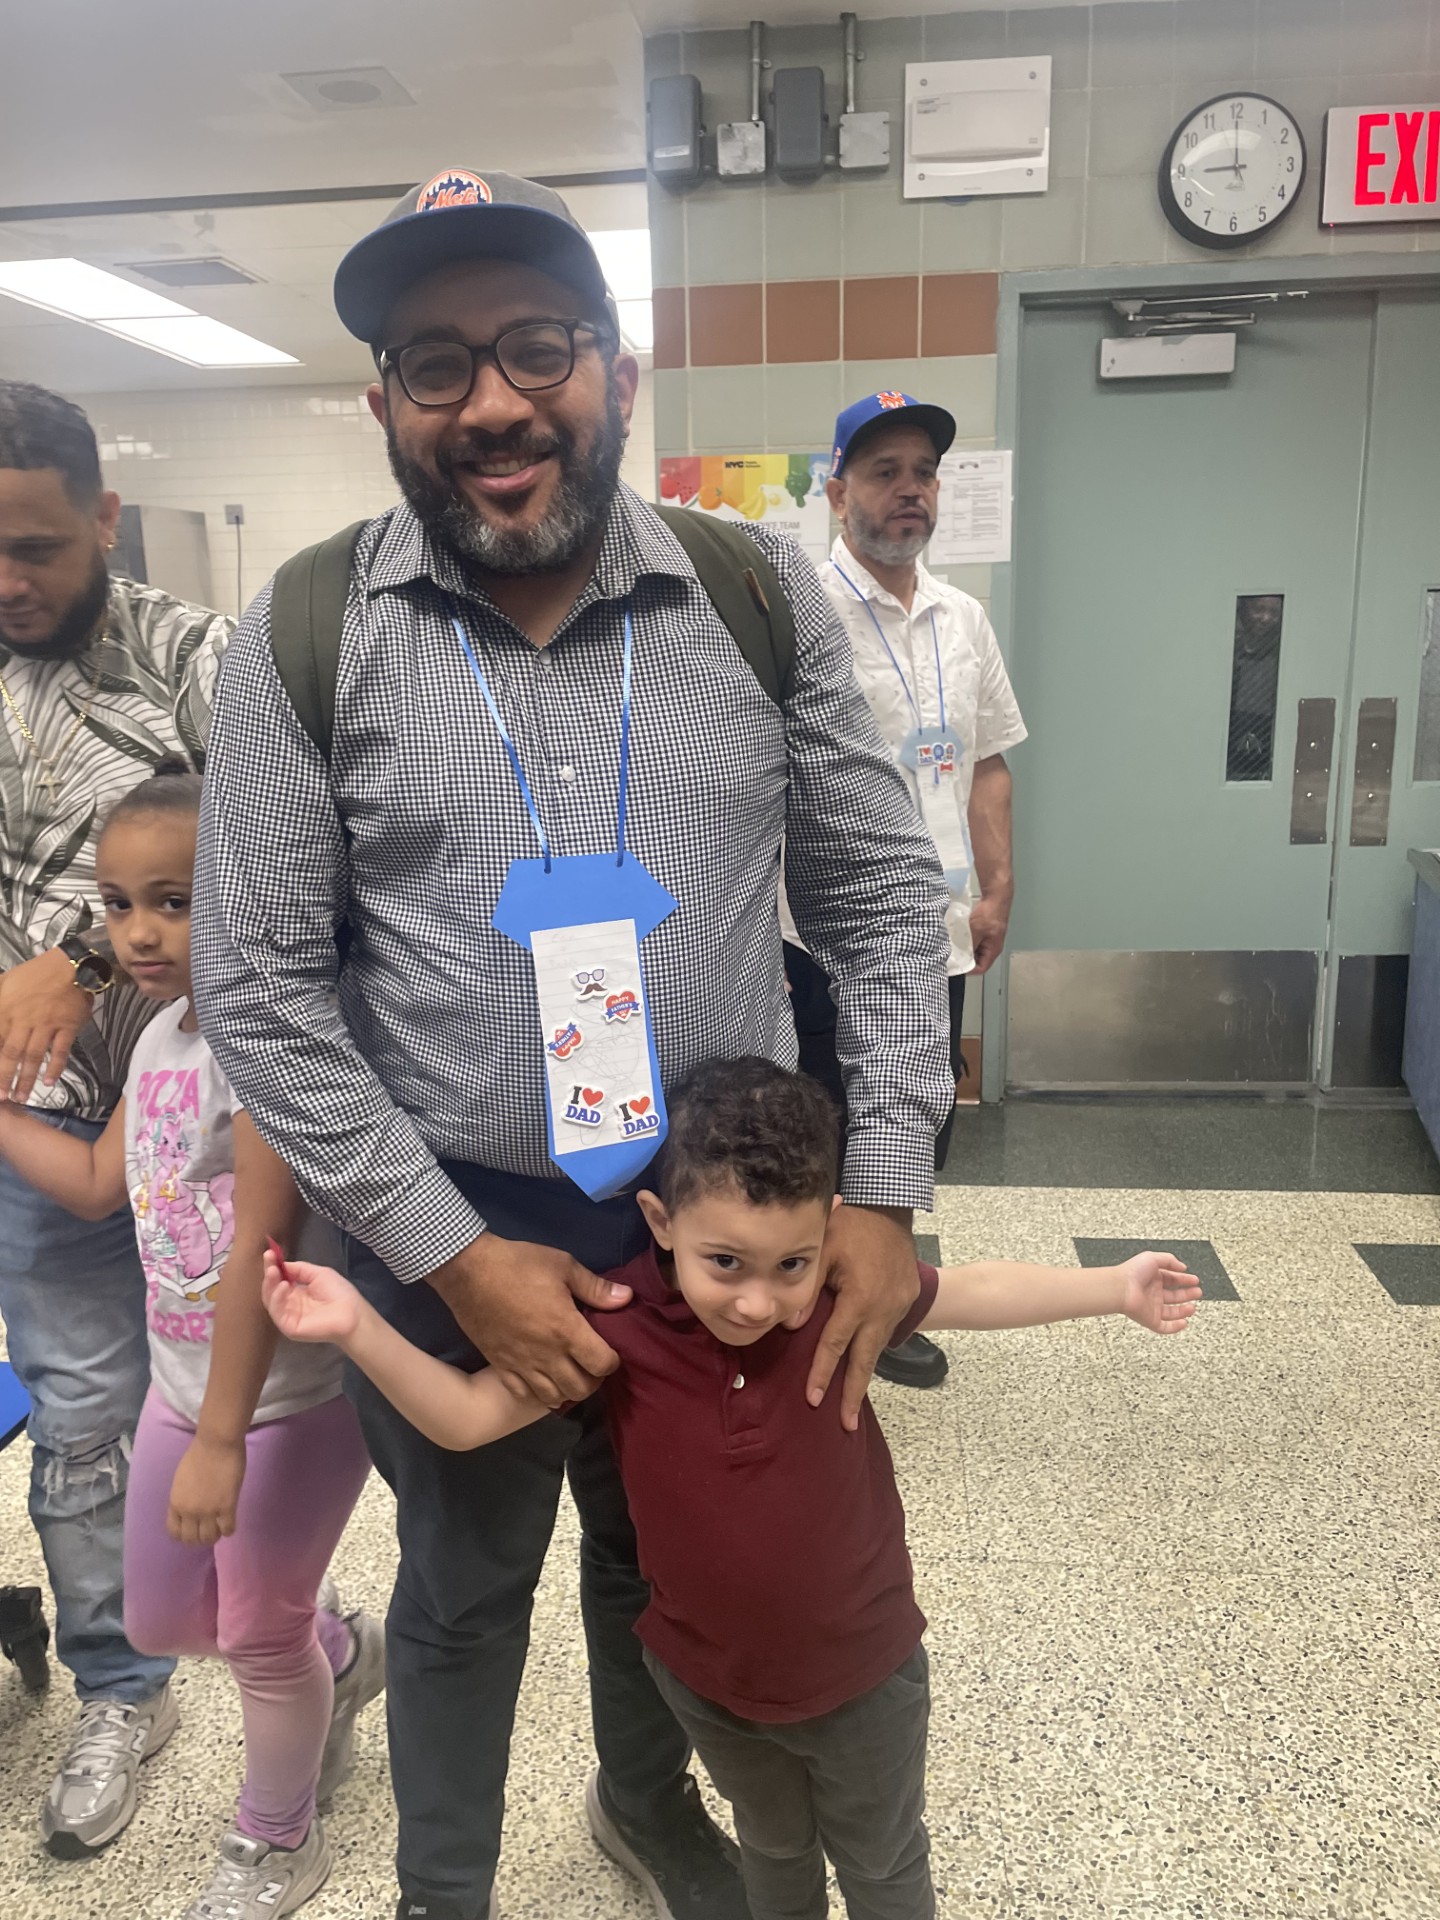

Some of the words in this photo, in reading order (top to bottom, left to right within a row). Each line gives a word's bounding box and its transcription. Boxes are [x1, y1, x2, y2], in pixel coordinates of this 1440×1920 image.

[1230, 103, 1244, 119] 12
[1262, 108, 1267, 125] 1
[1203, 113, 1215, 129] 11
[1184, 132, 1198, 149] 10
[1280, 128, 1289, 145] 2
[1286, 156, 1294, 173] 3
[1354, 110, 1440, 206] EXI
[1177, 163, 1185, 179] 9
[1184, 191, 1192, 208] 8
[1277, 184, 1285, 200] 4
[1203, 210, 1212, 226] 7
[1258, 206, 1266, 223] 5
[1229, 216, 1237, 232] 6
[611, 995, 630, 1004] HAPPY
[571, 1086, 582, 1105] I
[565, 1105, 601, 1124] DAD
[619, 1103, 632, 1122] I
[623, 1115, 659, 1135] DAD
